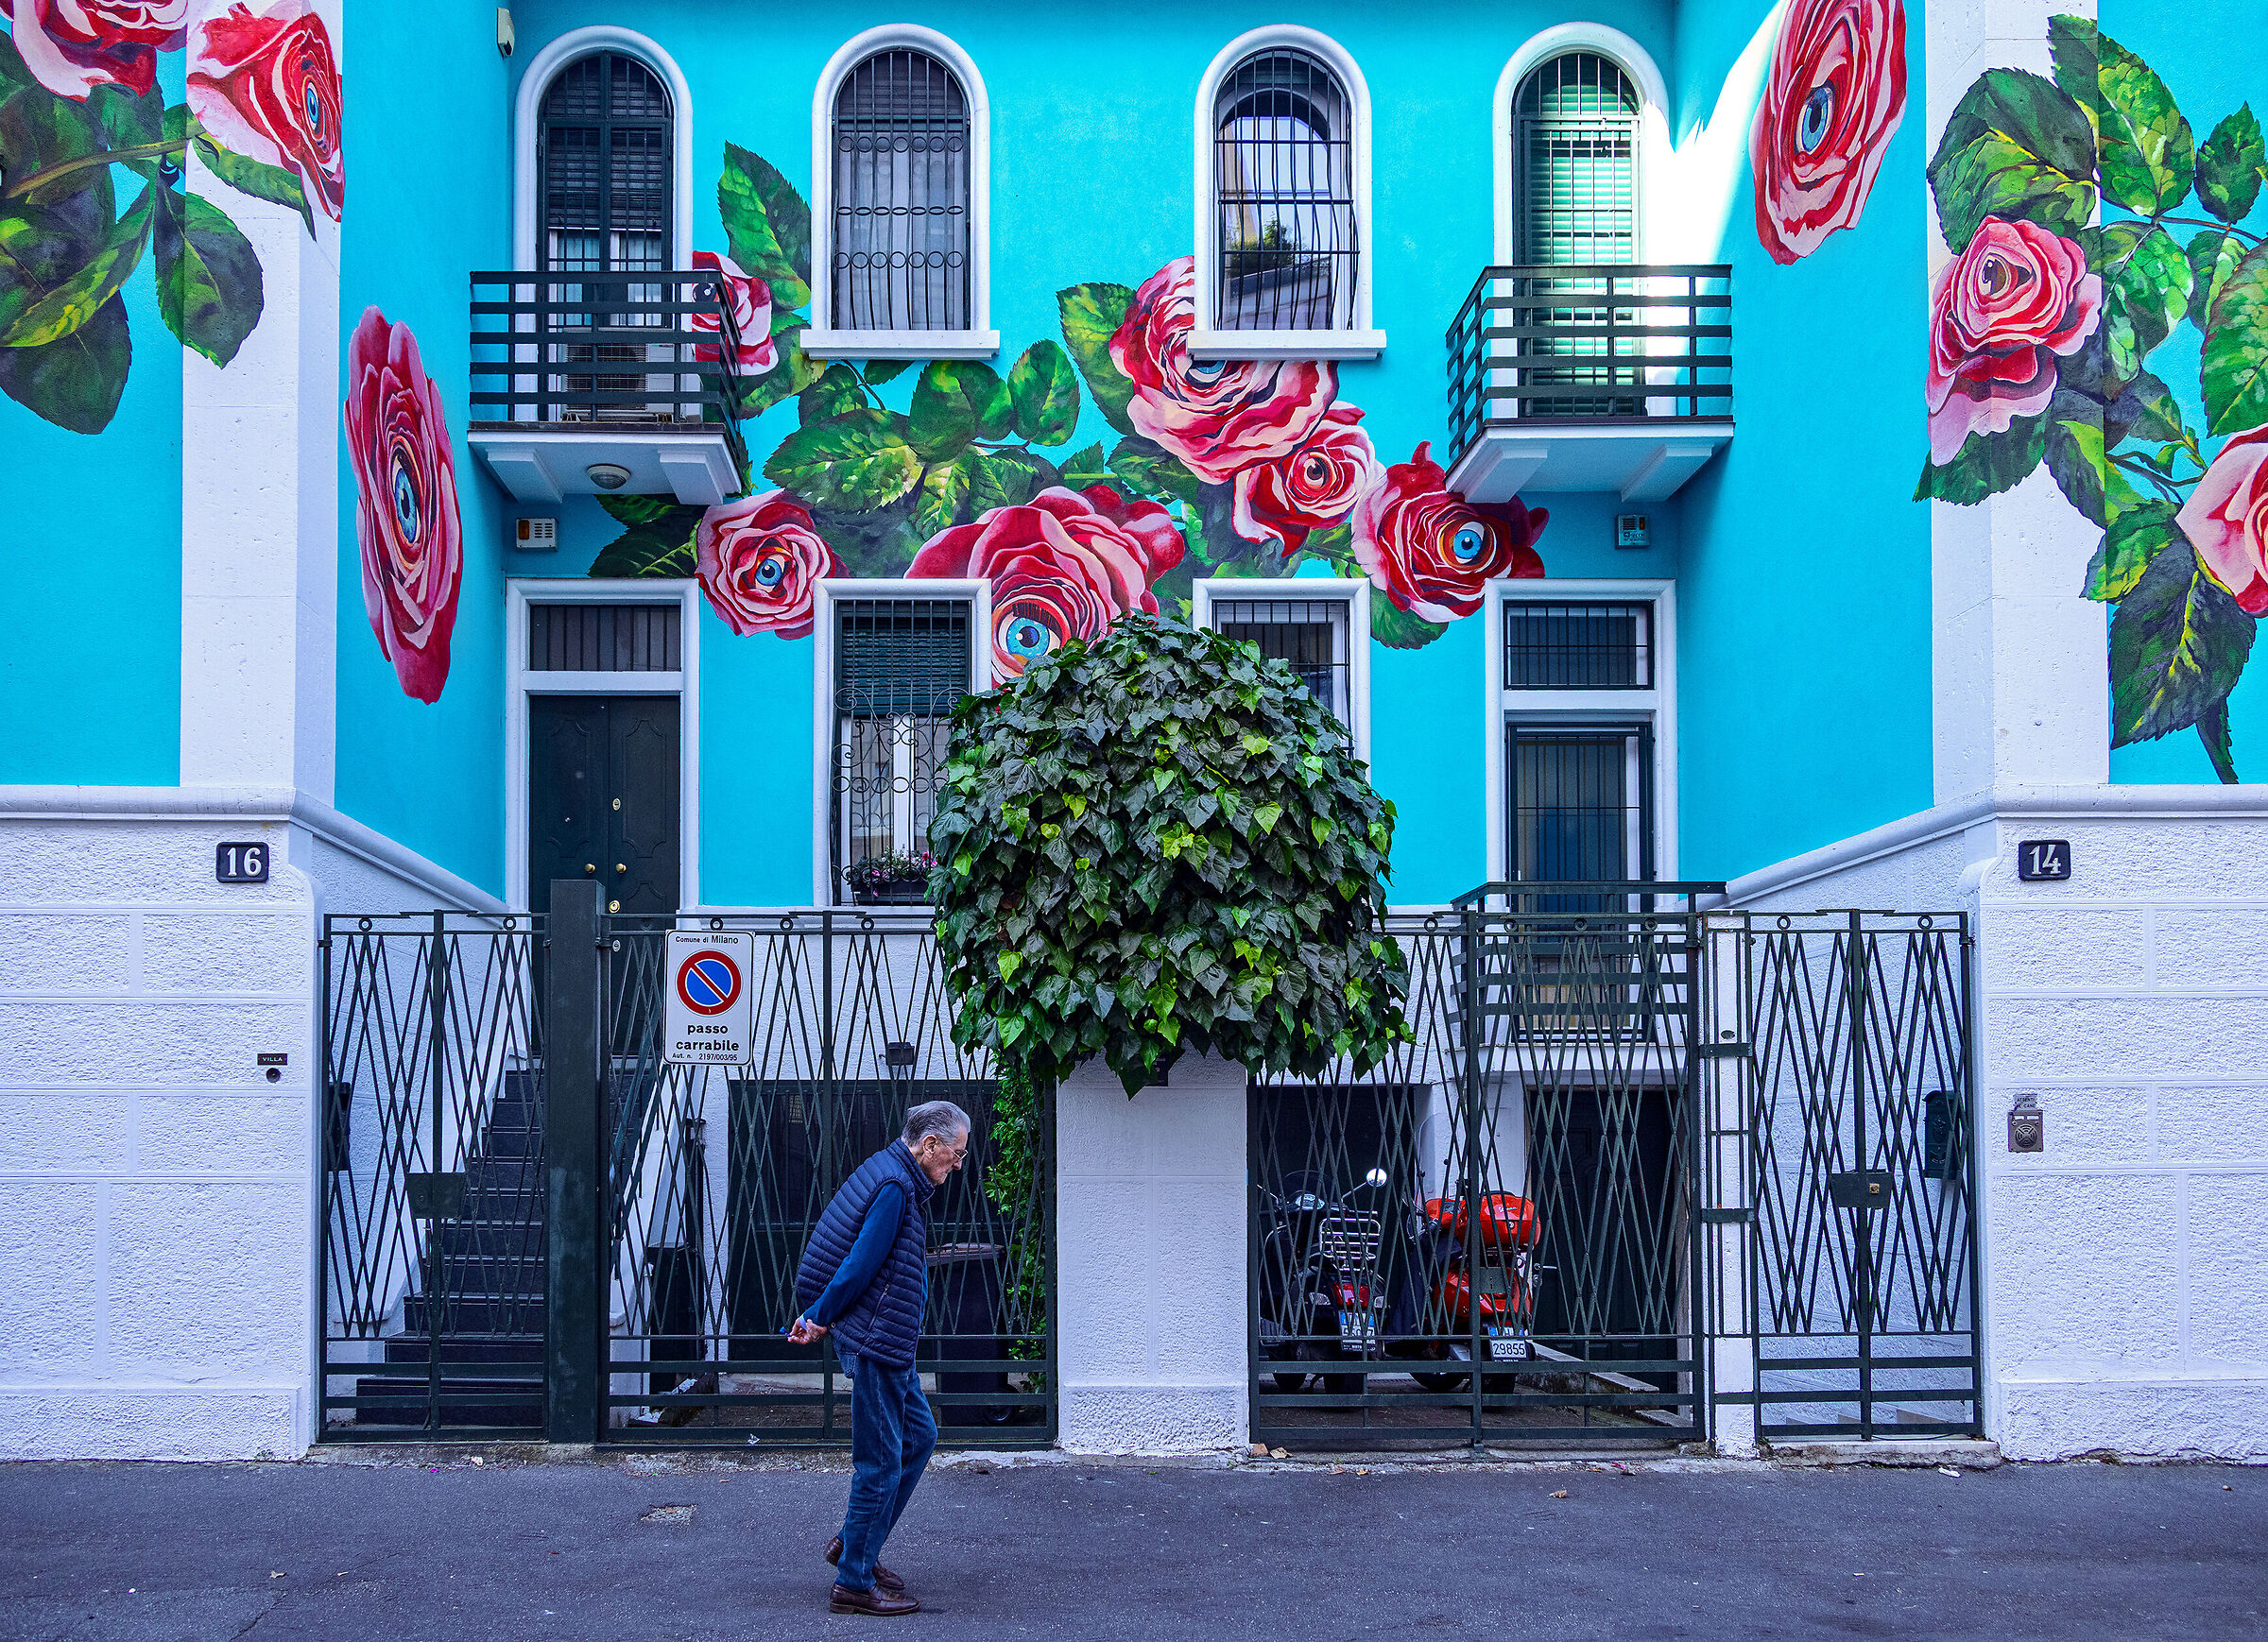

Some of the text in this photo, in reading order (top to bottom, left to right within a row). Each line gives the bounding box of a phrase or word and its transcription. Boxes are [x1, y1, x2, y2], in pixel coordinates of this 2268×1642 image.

[227, 847, 262, 877] 16
[2029, 845, 2062, 875] 14
[711, 934, 739, 945] Milano
[687, 1024, 729, 1035] passo
[676, 1040, 740, 1052] carrabile
[698, 1052, 738, 1061] 2197/003/95
[1493, 1343, 1525, 1356] 29855
